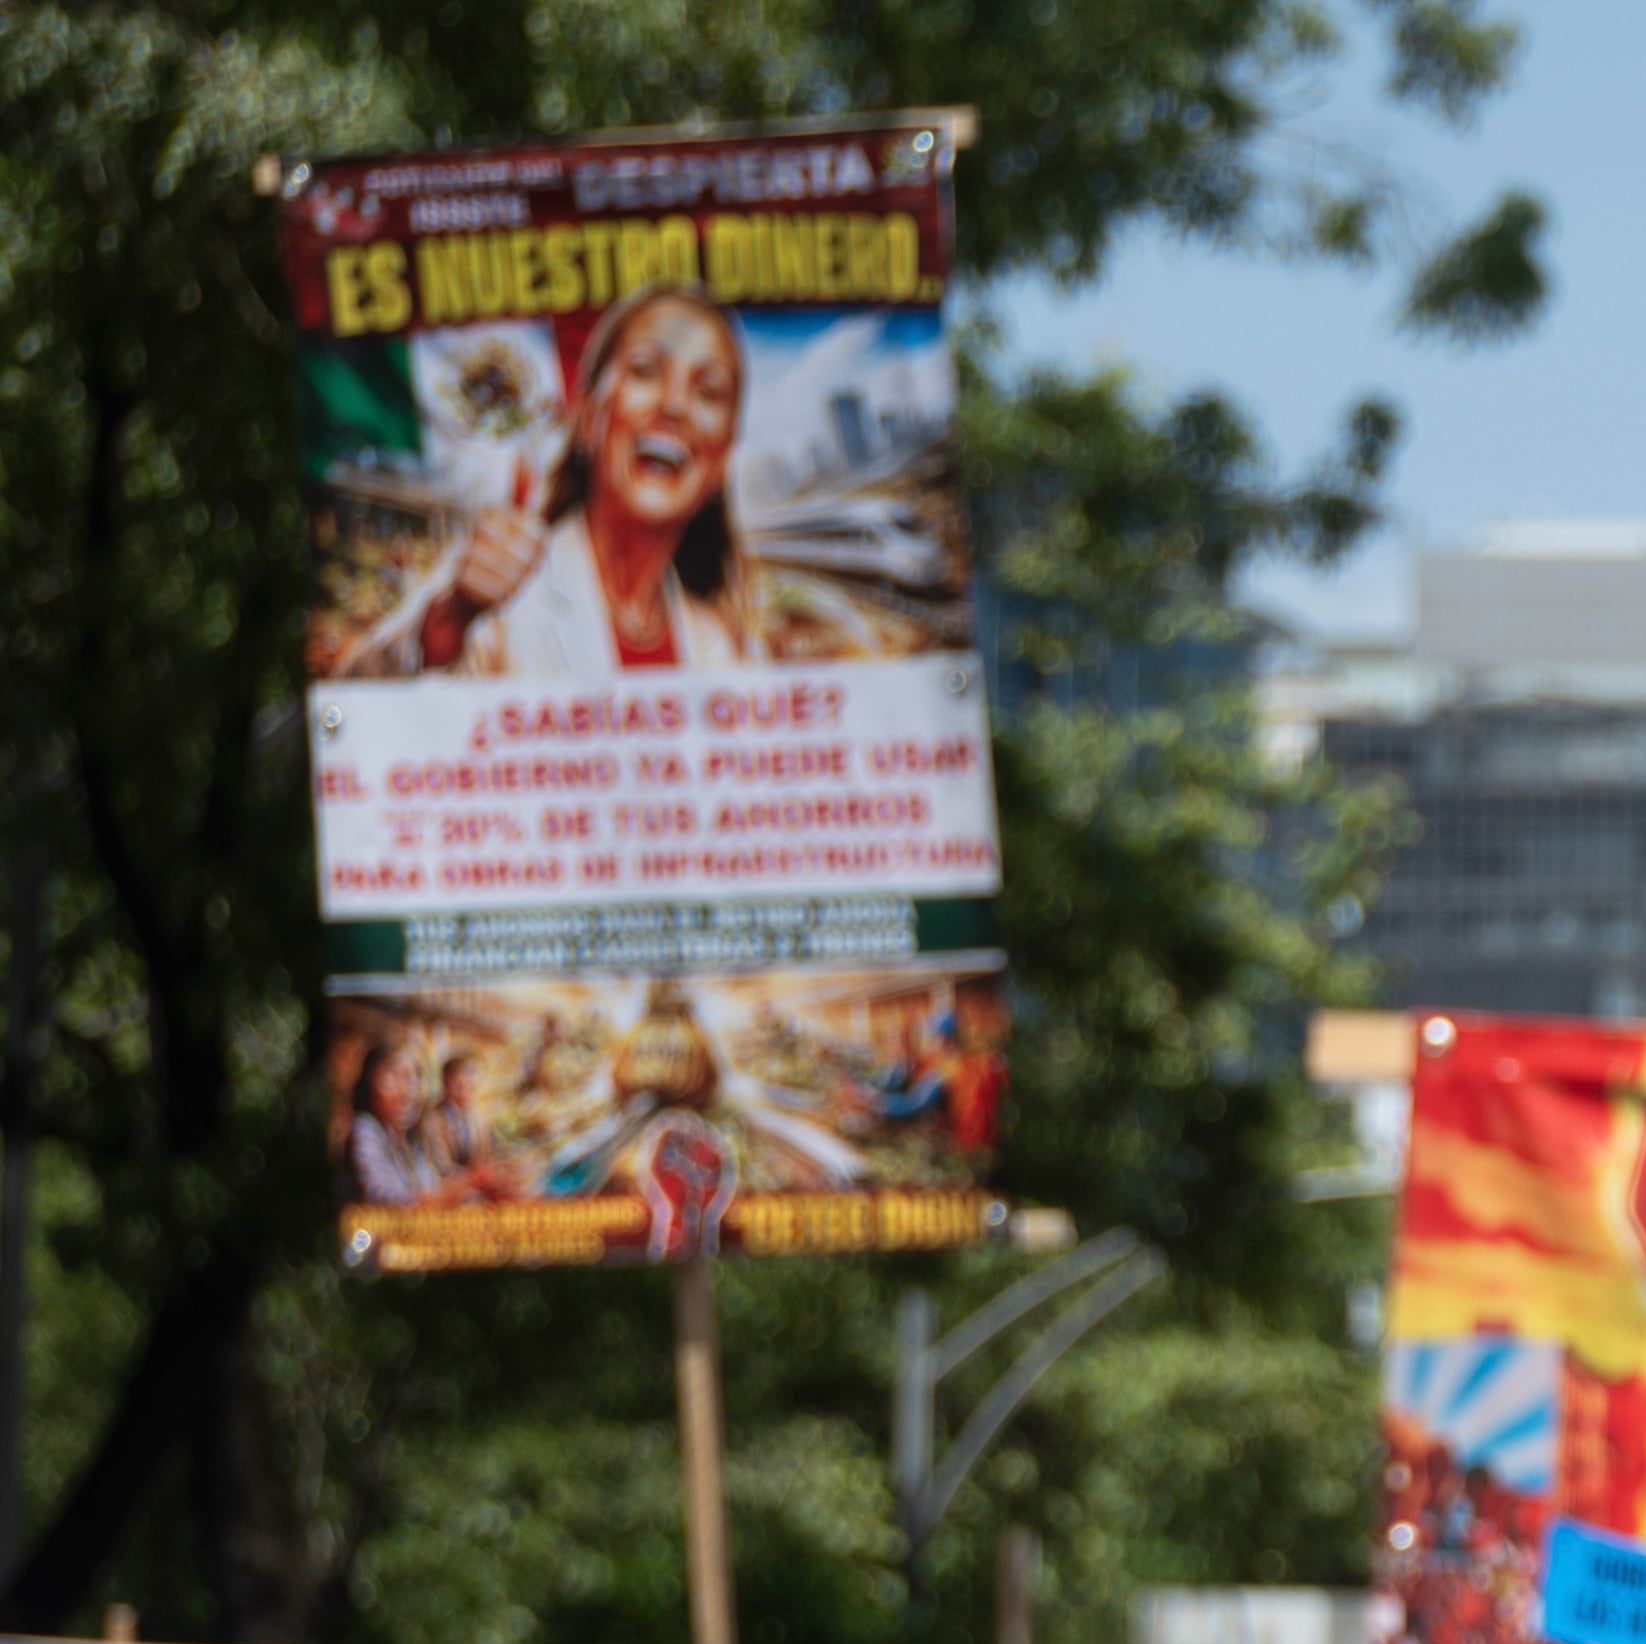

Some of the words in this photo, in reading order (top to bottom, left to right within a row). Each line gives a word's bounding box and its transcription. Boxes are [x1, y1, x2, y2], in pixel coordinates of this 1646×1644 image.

[327, 241, 412, 337] ES
[415, 214, 697, 323] NUESTRO
[319, 765, 368, 799] EL
[387, 757, 619, 799] GOBIERNO
[635, 752, 685, 786] YA
[705, 745, 847, 785] PUEDE
[540, 806, 592, 841] DE
[612, 800, 695, 837] TUS
[713, 791, 931, 836] AHORROS
